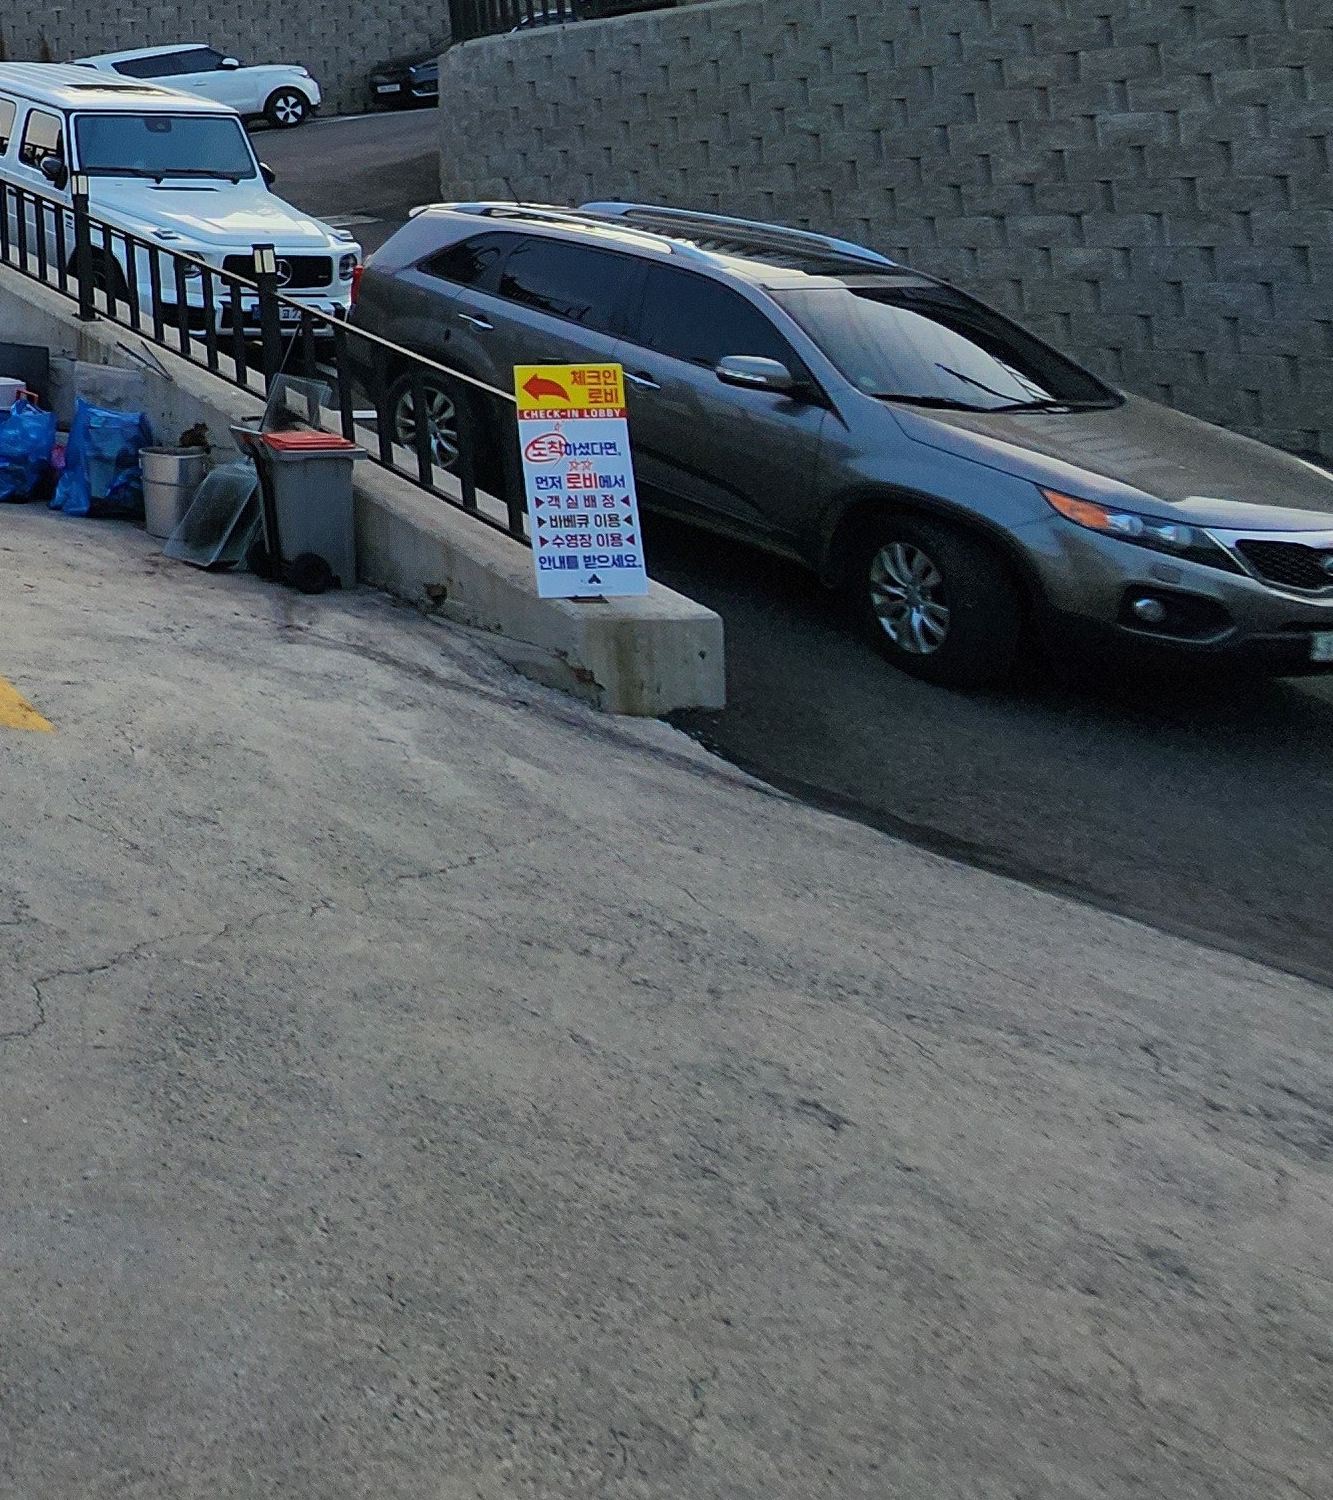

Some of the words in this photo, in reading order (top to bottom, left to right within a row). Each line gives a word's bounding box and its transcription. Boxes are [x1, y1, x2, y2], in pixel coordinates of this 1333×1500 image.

[570, 369, 618, 386] 체크인
[588, 388, 619, 404] 로비
[523, 409, 579, 419] CHECK-IN
[584, 409, 621, 418] LOBBY
[535, 475, 563, 490] 먼저
[566, 472, 626, 489] 로비에서
[549, 514, 589, 529] 바베큐
[594, 513, 621, 528] 이용
[552, 533, 592, 548] 수영장
[596, 532, 623, 547] 이용
[583, 553, 643, 570] 받으세요.
